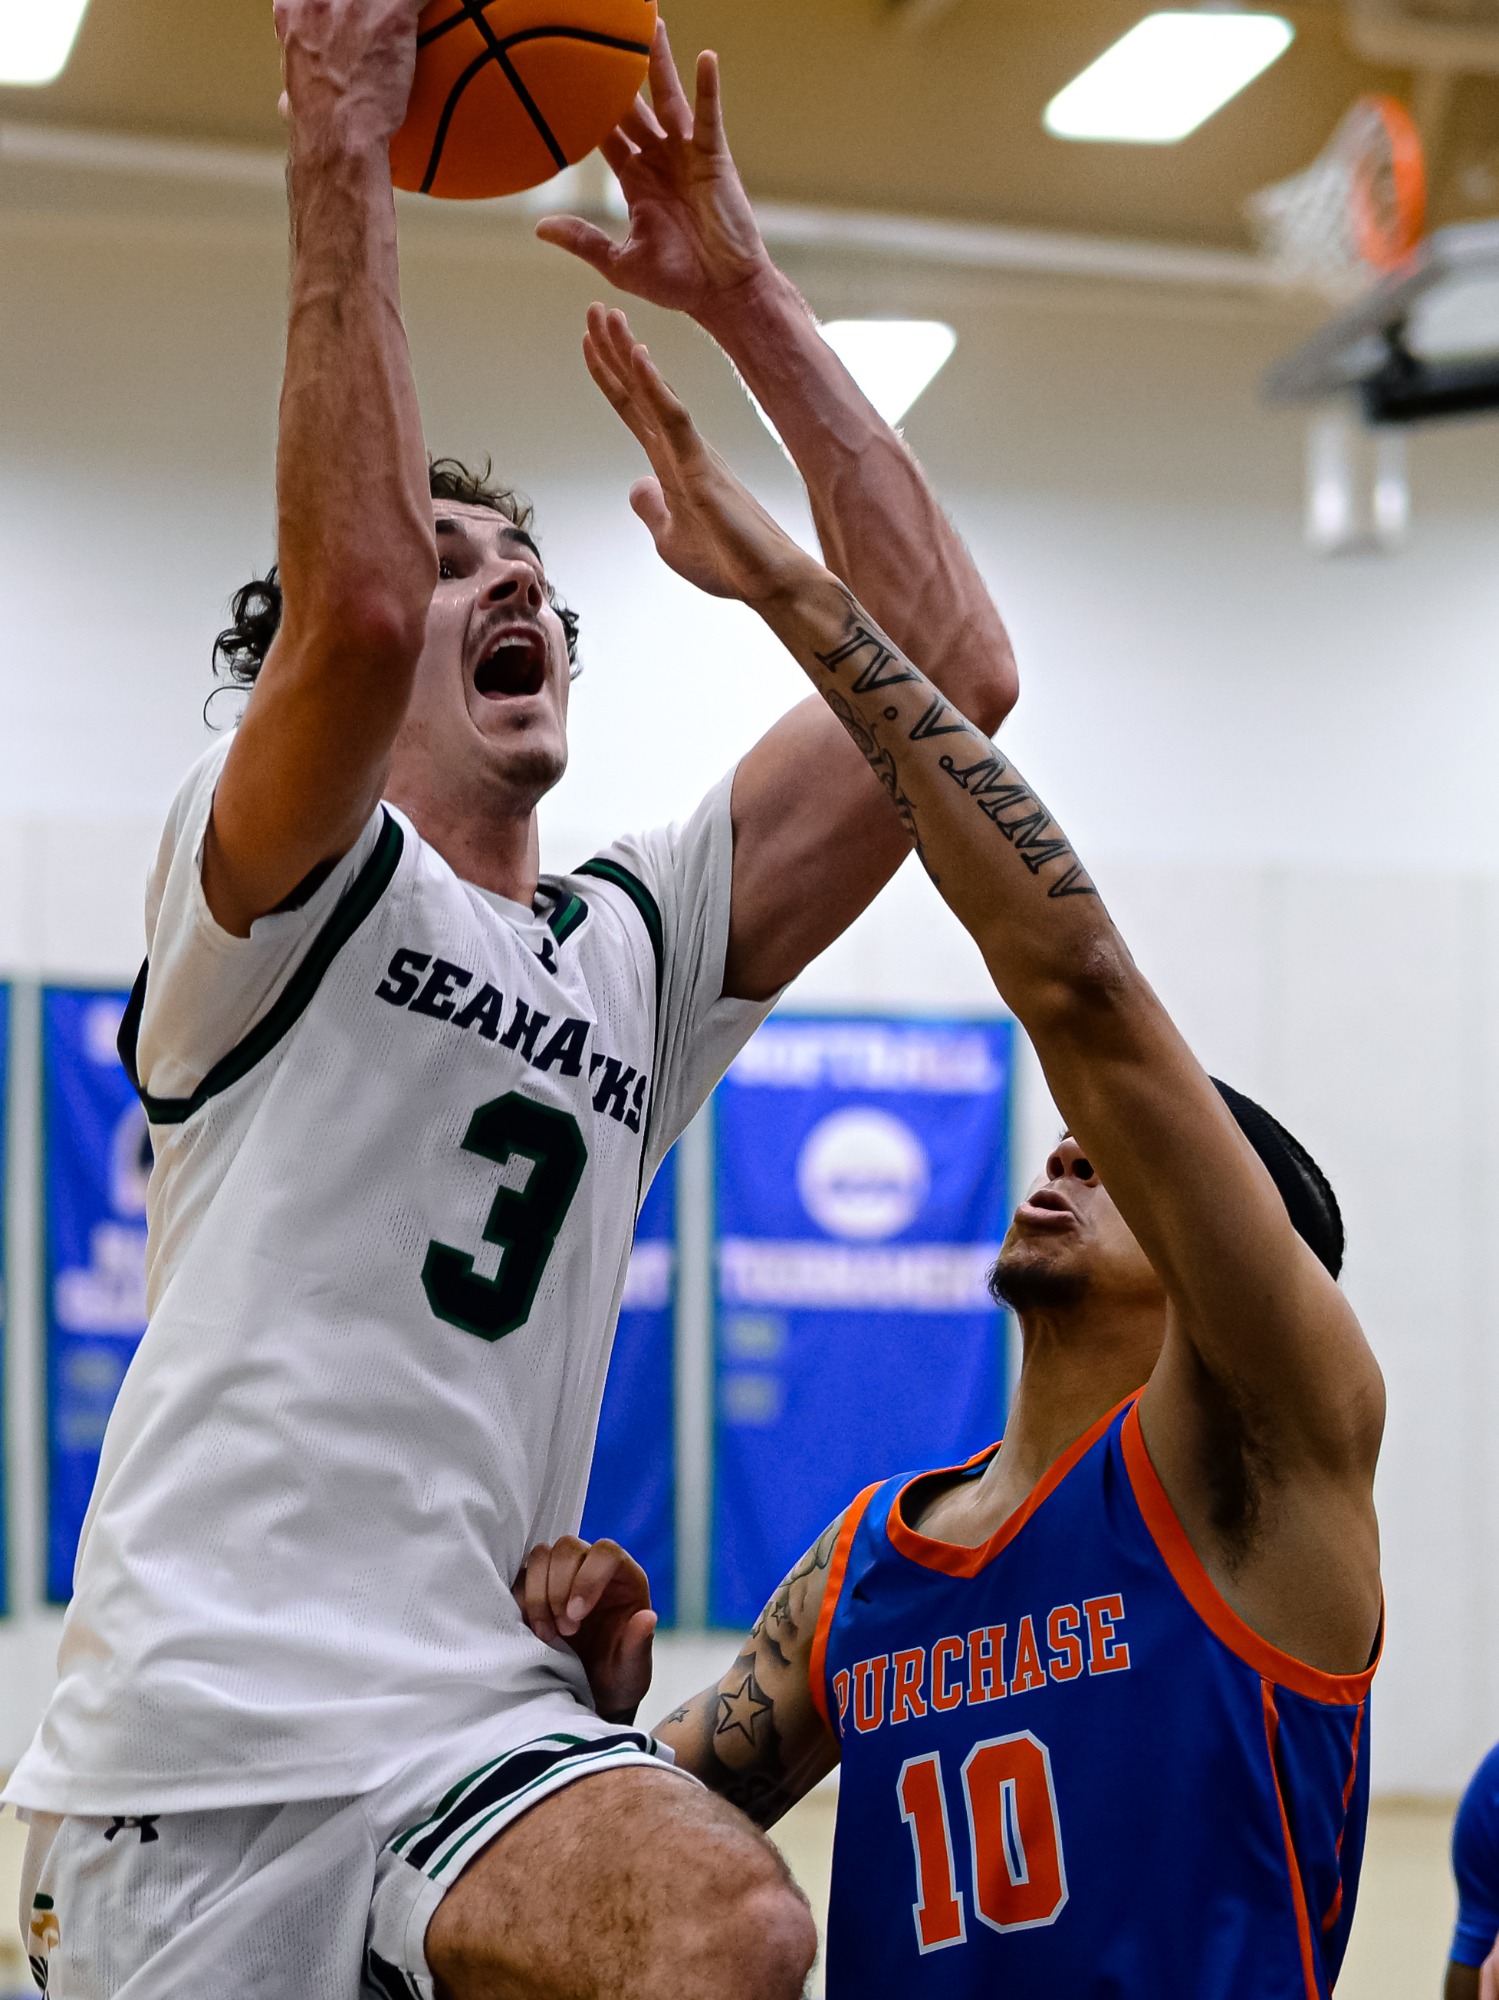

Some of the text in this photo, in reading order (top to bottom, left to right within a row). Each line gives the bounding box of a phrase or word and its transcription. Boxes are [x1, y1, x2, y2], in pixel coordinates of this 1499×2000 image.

[421, 1090, 588, 1342] 3
[832, 1593, 1131, 1738] PURCHASE
[896, 1729, 1069, 1955] 10
